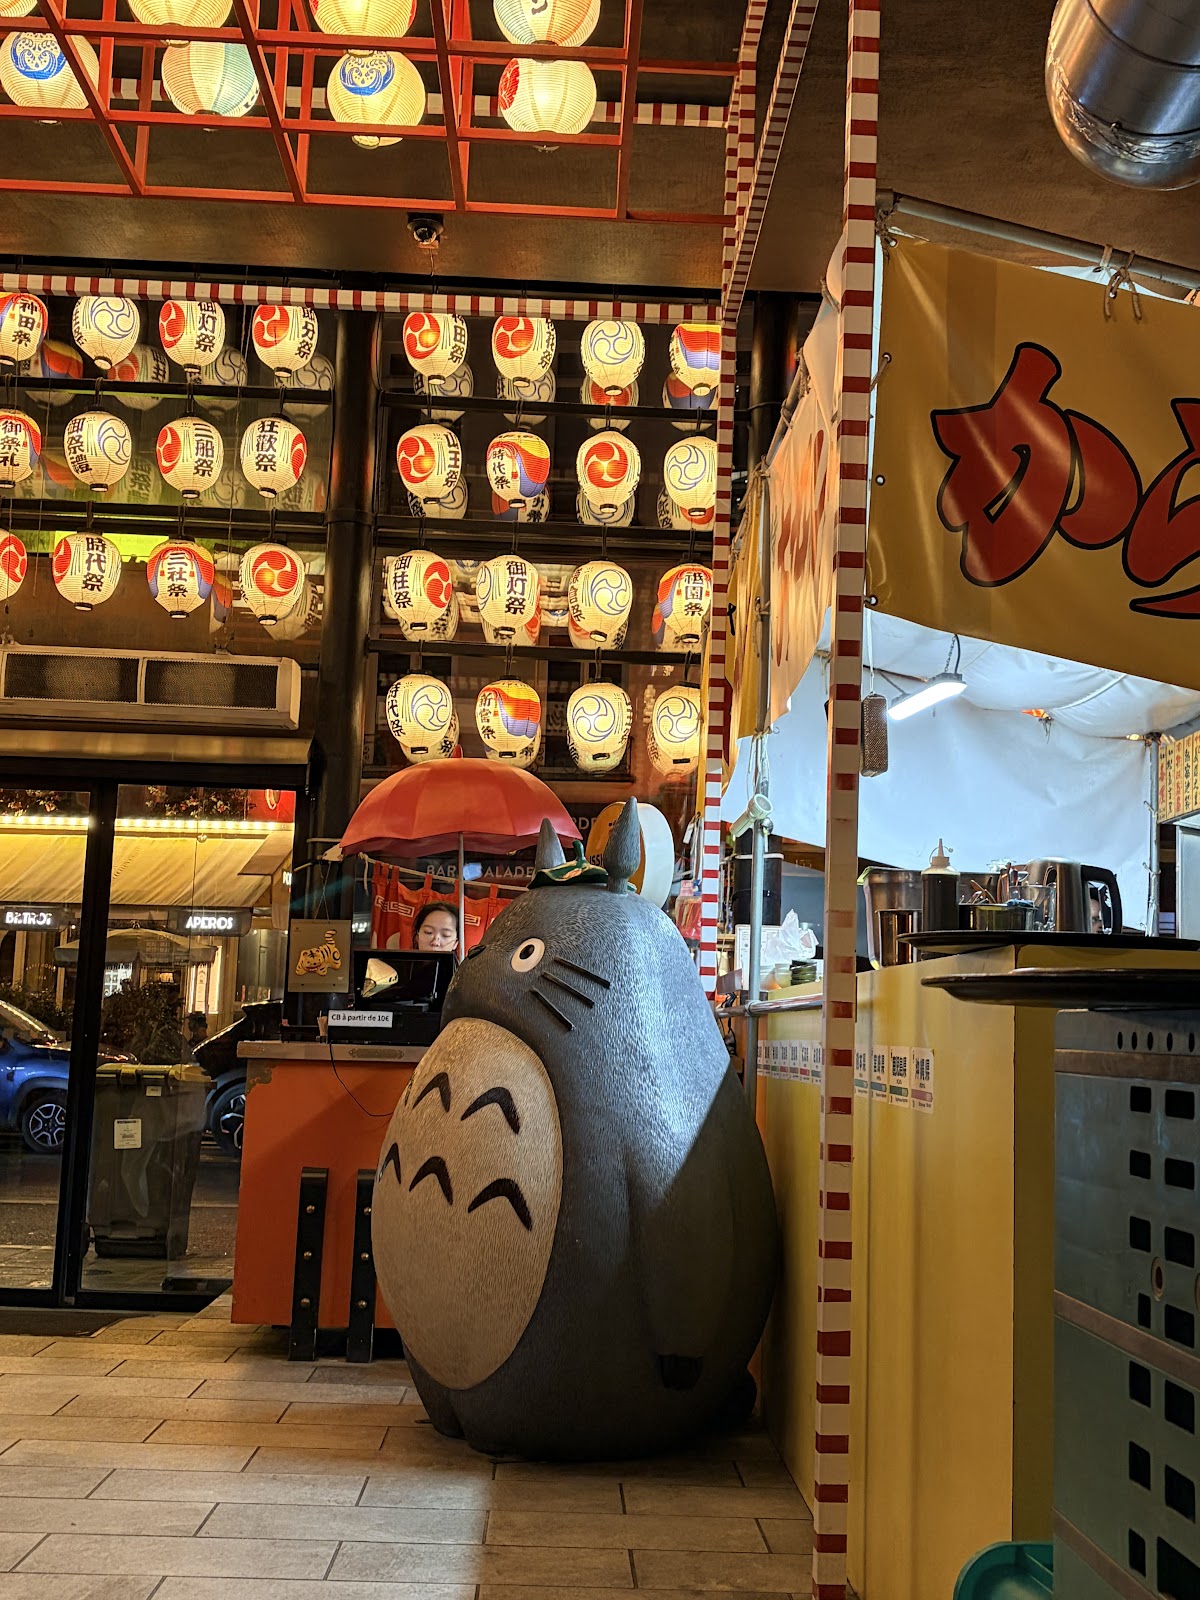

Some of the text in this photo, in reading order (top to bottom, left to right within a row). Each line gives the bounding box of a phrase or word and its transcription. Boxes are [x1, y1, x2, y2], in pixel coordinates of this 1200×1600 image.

[12, 299, 38, 348] 神田祭
[193, 422, 214, 477] 三船祭
[443, 431, 461, 488] 山王祭
[492, 448, 511, 490] 時代祭
[81, 537, 107, 592] 時代祭
[167, 552, 188, 598] 三社祭
[393, 555, 413, 609] 御柱祭
[504, 560, 528, 615] 御灯祭
[426, 864, 457, 877] BAR
[331, 1013, 341, 1021] CB
[342, 1012, 347, 1021] à
[347, 1014, 366, 1022] partir
